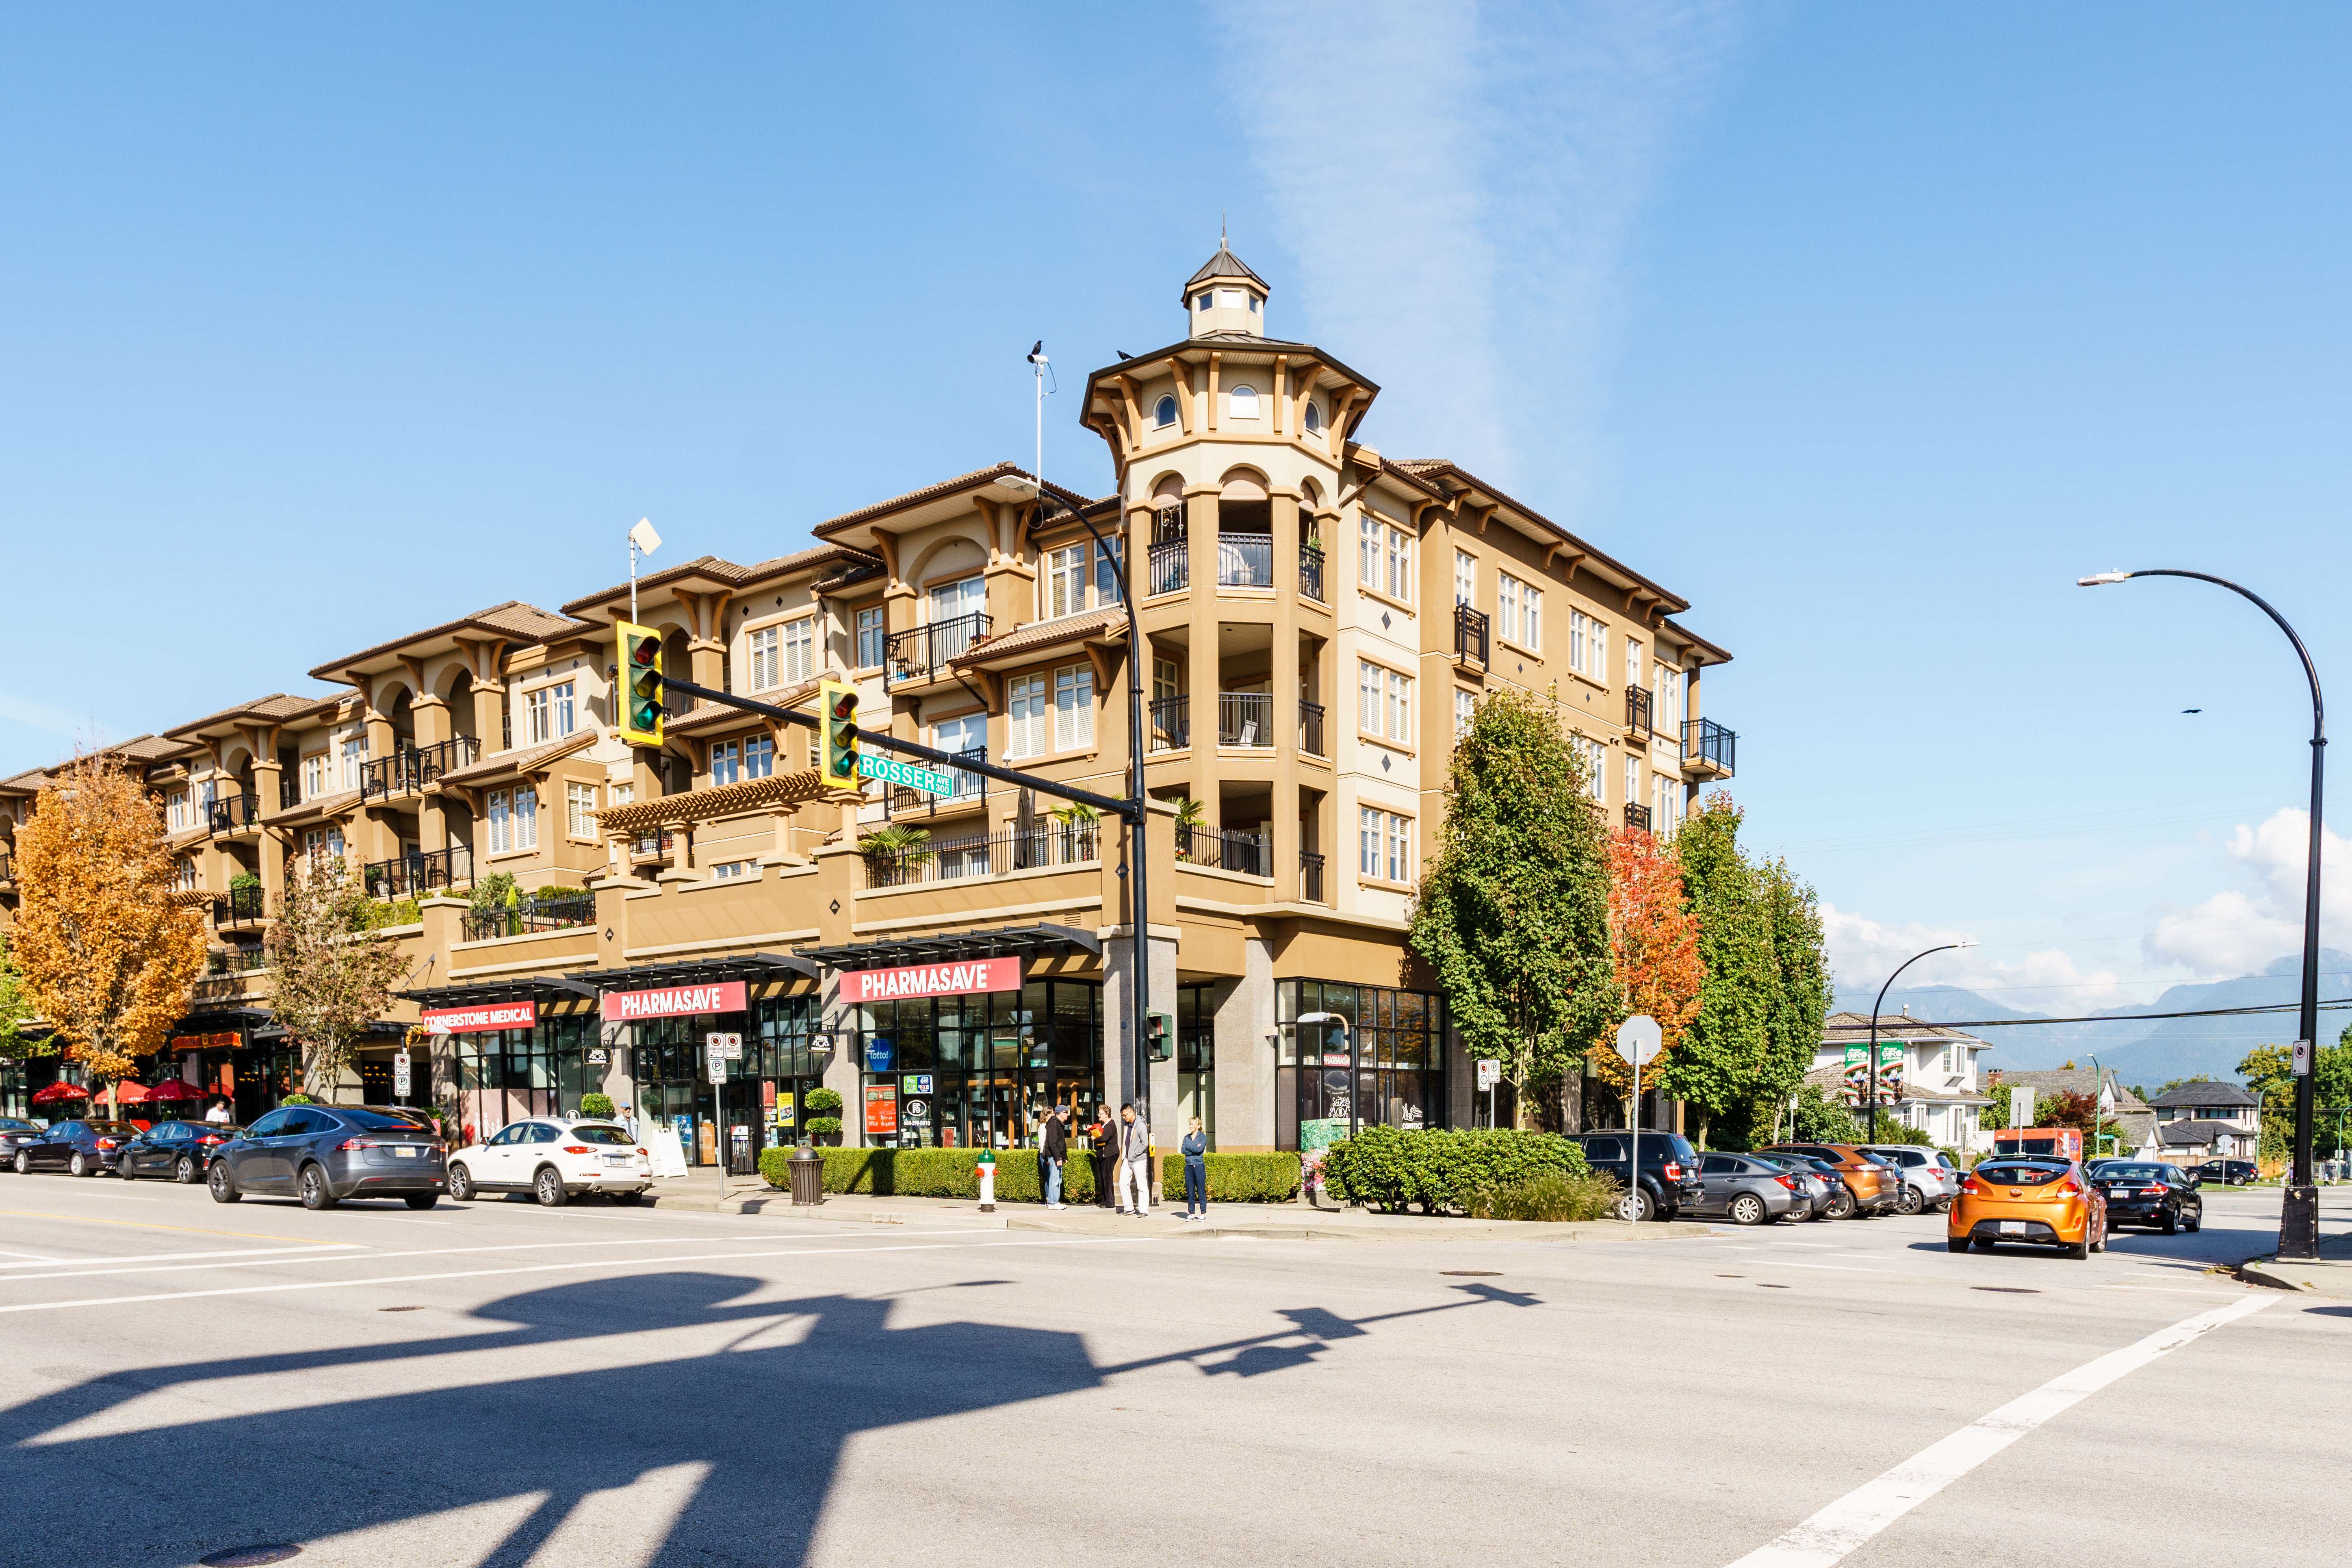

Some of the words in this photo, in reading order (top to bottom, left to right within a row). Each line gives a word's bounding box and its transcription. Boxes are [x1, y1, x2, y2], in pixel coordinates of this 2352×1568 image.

[863, 757, 934, 790] ROSSER
[936, 776, 949, 786] AVE
[936, 784, 949, 794] 300
[862, 964, 987, 998] PHARMASAVE
[621, 987, 720, 1016] PHARMASAVE
[424, 1011, 488, 1027] CORNERSTONE
[490, 1008, 532, 1024] MEDICAL
